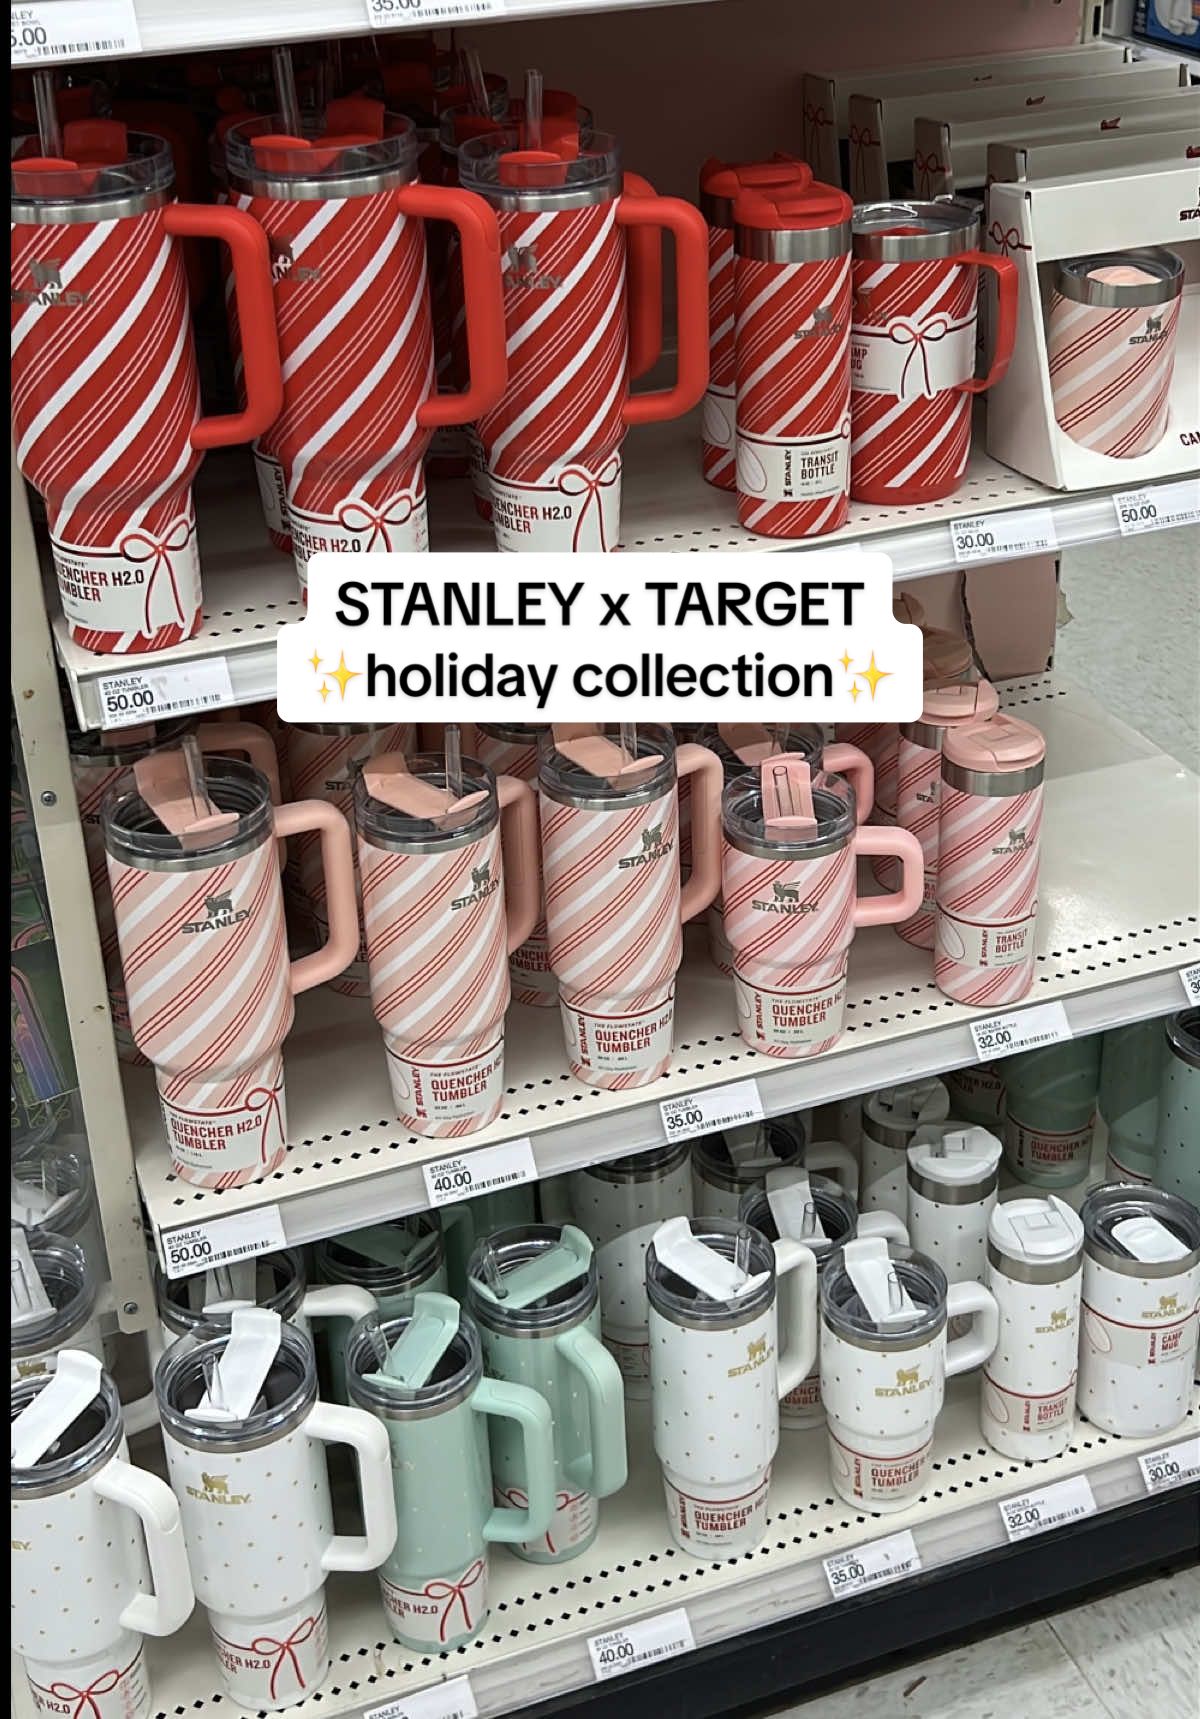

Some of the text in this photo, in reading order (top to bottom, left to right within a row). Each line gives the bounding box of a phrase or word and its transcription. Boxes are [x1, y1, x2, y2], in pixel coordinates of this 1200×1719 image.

[801, 450, 839, 468] TRANSIT
[801, 464, 835, 480] BOTTLE
[542, 505, 572, 521] H2.0
[1121, 504, 1157, 523] 50.00
[953, 520, 985, 531] STANLEY
[330, 537, 362, 553] H2.0
[956, 532, 994, 550] 30.00
[111, 569, 145, 587] H2.0
[102, 676, 143, 690] STANLEY
[107, 690, 154, 712] 50.00
[619, 838, 673, 869] STANLEY
[451, 879, 499, 910] STANLEY
[752, 899, 818, 914] STANLEY
[181, 908, 251, 934] STANLEY
[996, 928, 1028, 944] TRANSIT
[995, 939, 1024, 953] BOTTLE
[772, 998, 833, 1016] QUENCHER
[773, 1011, 826, 1028] TUMBLER
[595, 1022, 657, 1042] QUENCHER
[978, 1030, 1011, 1048] 32.00
[596, 1037, 650, 1053] TUMBLER
[431, 1066, 493, 1090] QUENCHER
[432, 1080, 488, 1102] TUMBLER
[662, 1098, 693, 1112] STANLEY
[171, 1115, 262, 1138] QUENCHER H2.0
[667, 1109, 703, 1130] 35.00
[172, 1129, 226, 1150] TUMBLER
[429, 1160, 462, 1174] STANLEY
[434, 1171, 472, 1192] 40.00
[166, 1229, 202, 1245] STANLEY
[171, 1241, 212, 1263] 50.00
[1161, 1330, 1183, 1343] CAMP
[1161, 1339, 1179, 1351] MUG
[875, 1376, 932, 1397] STANLEY
[871, 1470, 919, 1488] TUMBLER
[1149, 1462, 1180, 1482] 30.00
[185, 1485, 252, 1505] STANLEY
[694, 1504, 753, 1522] QUENCHER
[1008, 1507, 1039, 1529] 32.00
[695, 1518, 746, 1532] TUMBLER
[831, 1563, 865, 1585] 35.00
[413, 1604, 438, 1615] H2.0
[599, 1642, 634, 1664] 40.00
[245, 1659, 271, 1669] H2.0
[46, 1700, 71, 1715] H2.0
